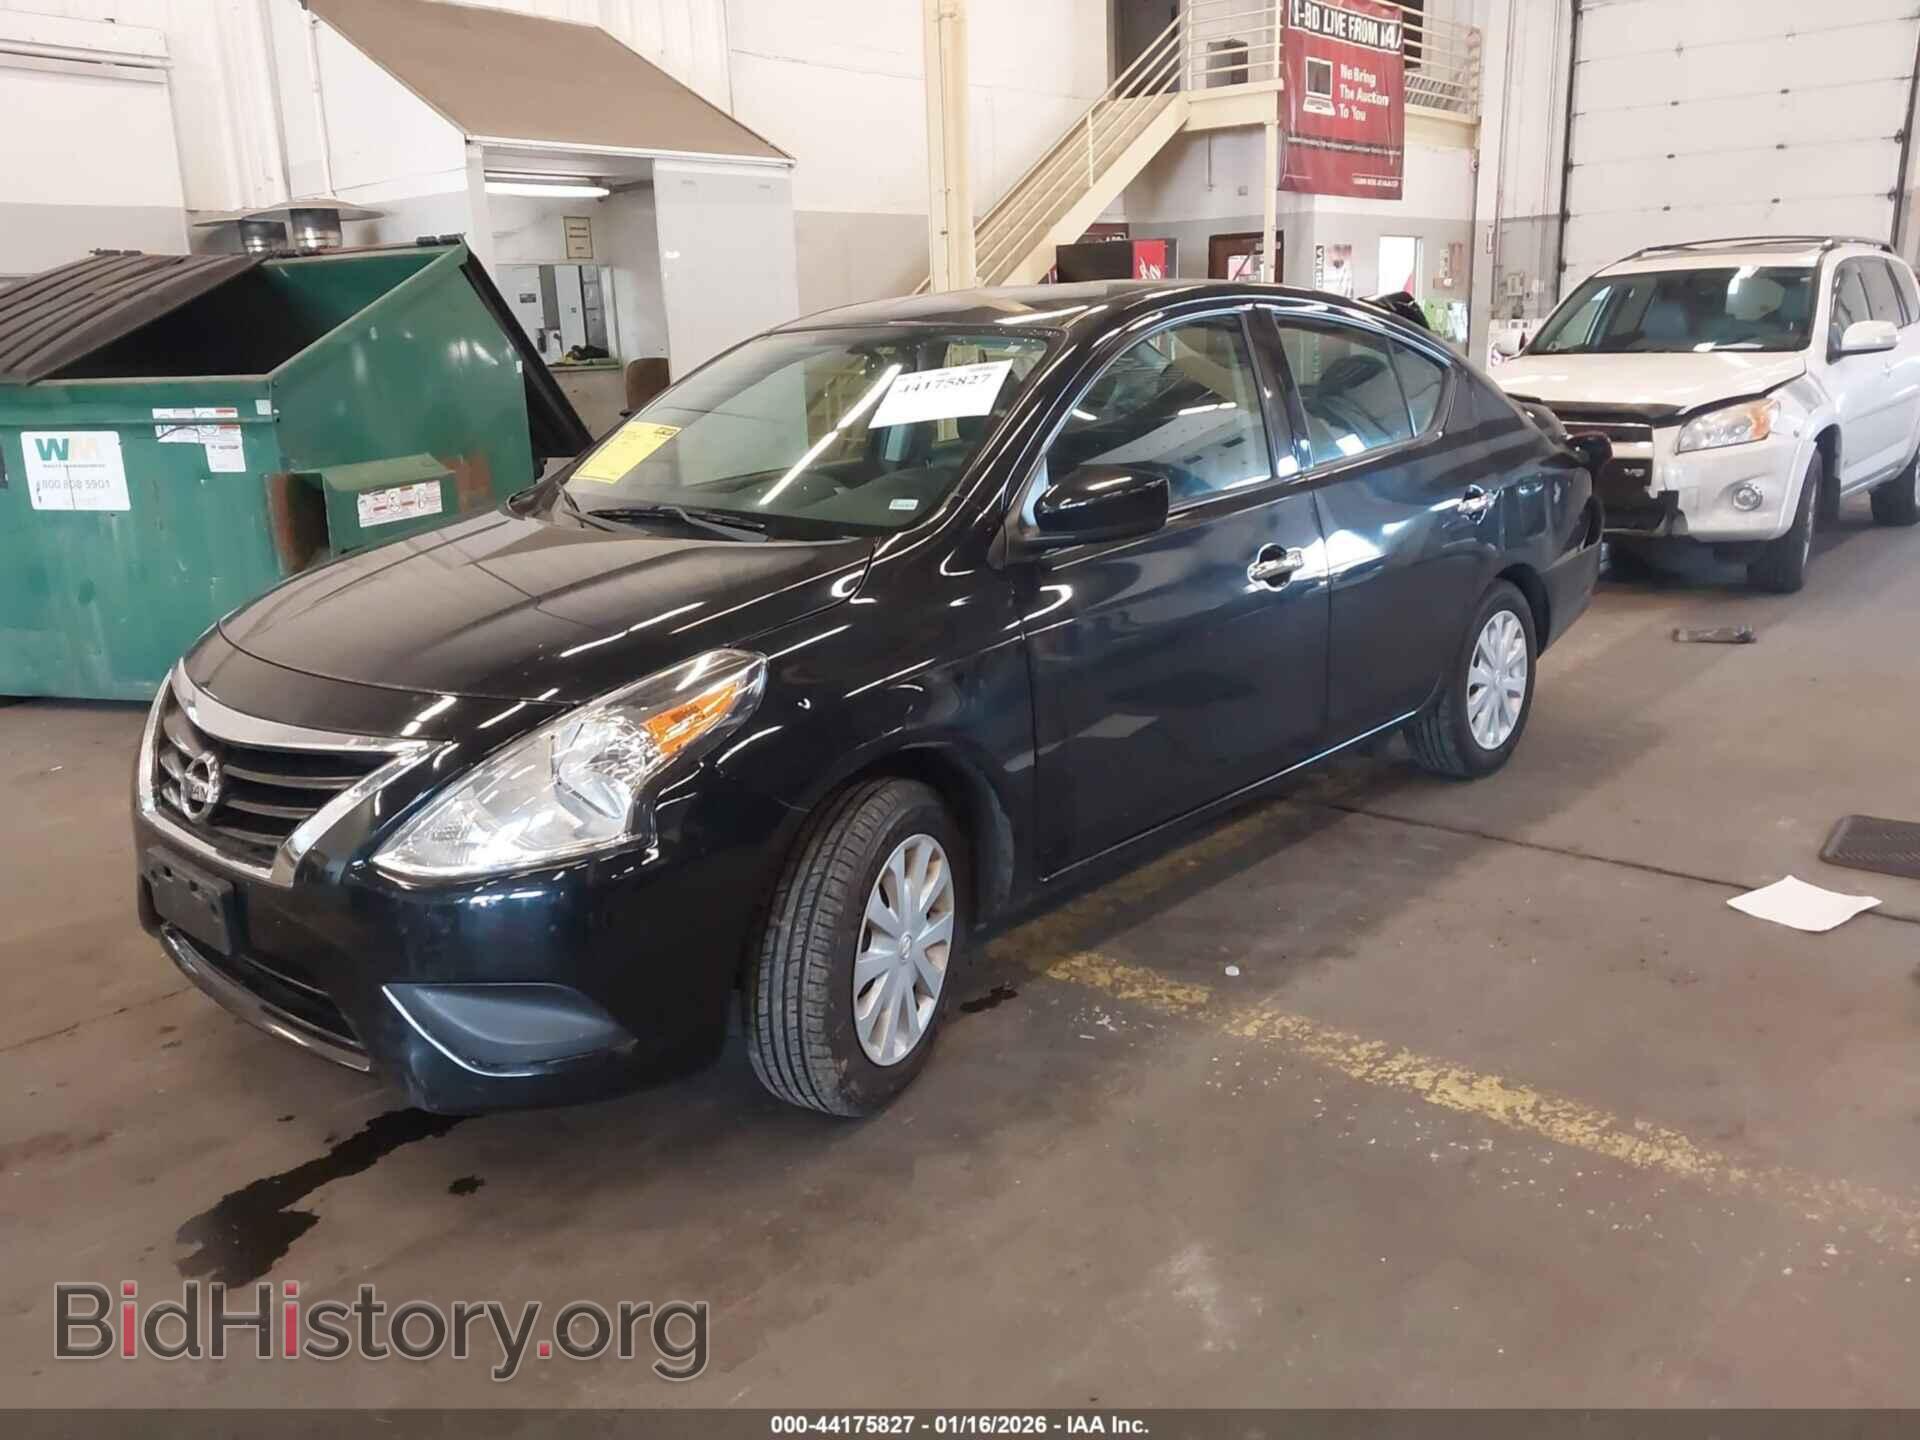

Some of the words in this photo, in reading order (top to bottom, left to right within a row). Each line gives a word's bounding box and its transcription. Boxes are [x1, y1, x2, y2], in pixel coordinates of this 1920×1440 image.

[1323, 8, 1347, 37] LIVE
[1348, 16, 1378, 45] FROM
[1353, 67, 1376, 87] Bring
[1340, 84, 1354, 100] The
[1339, 104, 1349, 119] To
[1351, 106, 1366, 122] You
